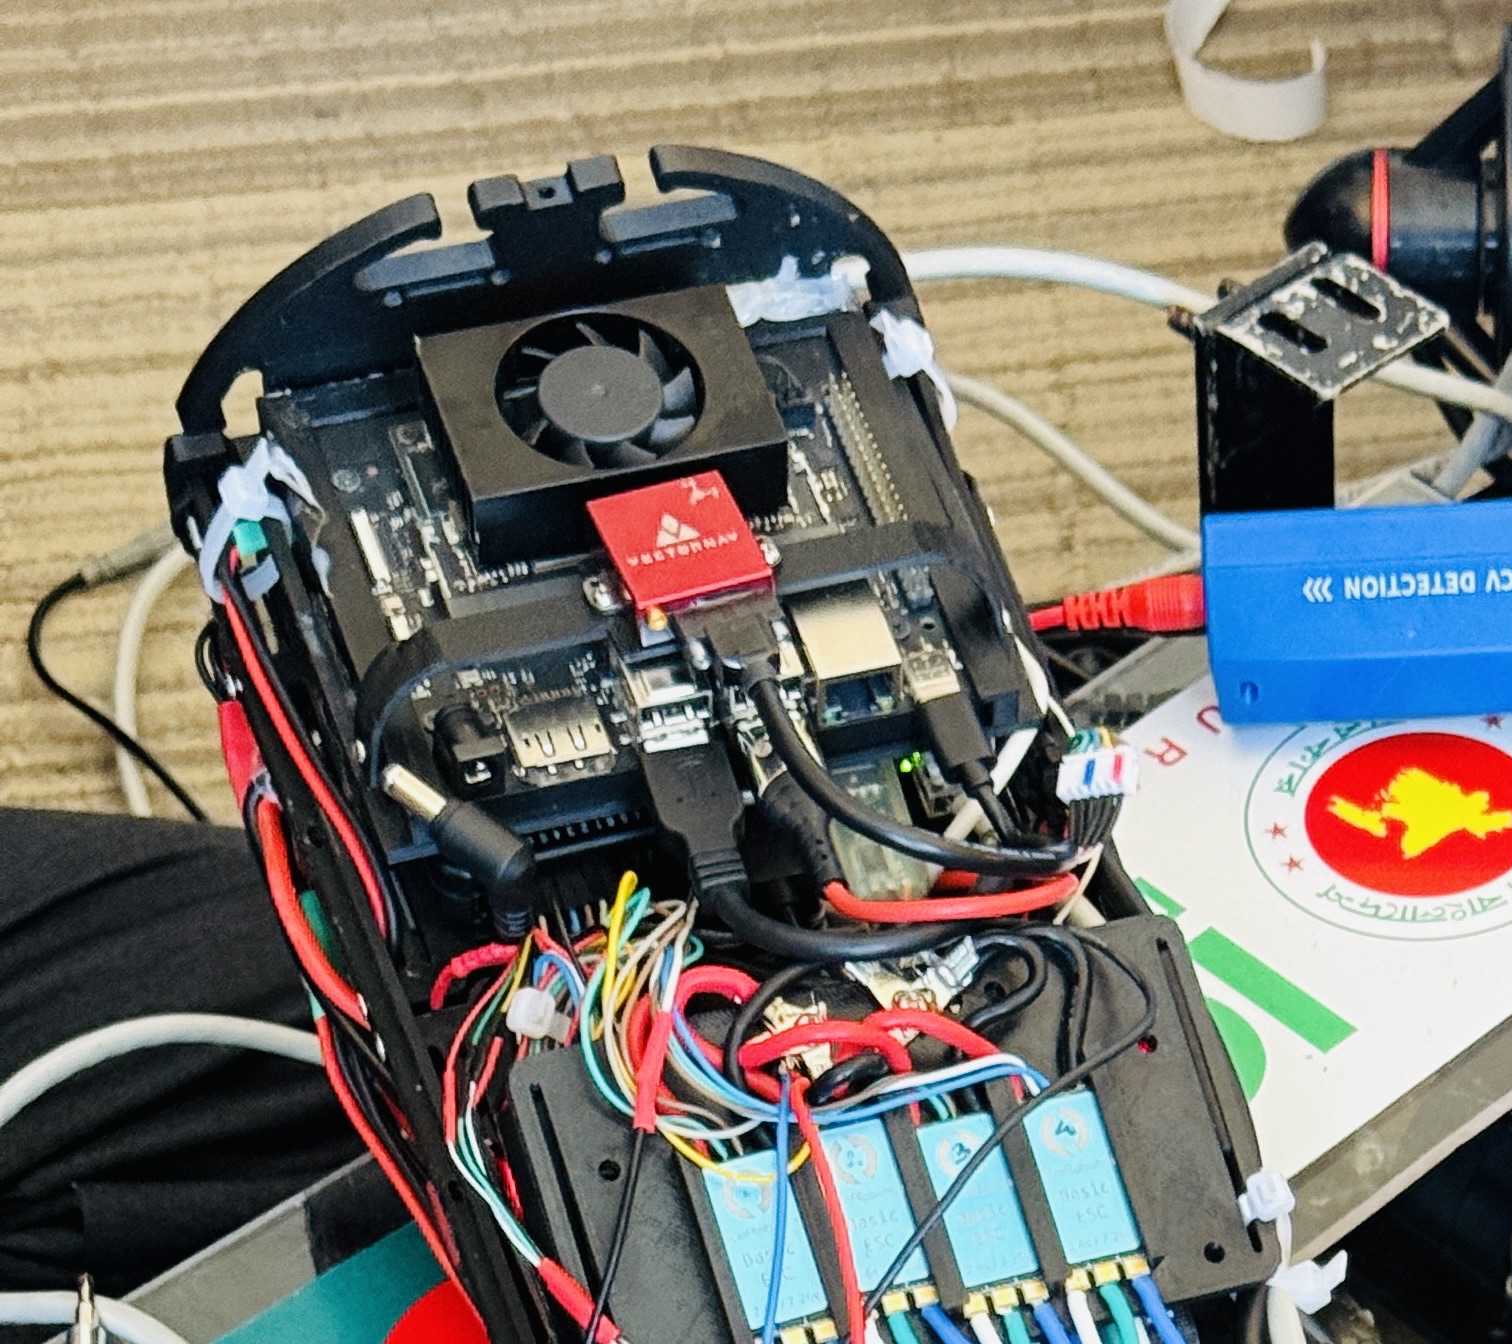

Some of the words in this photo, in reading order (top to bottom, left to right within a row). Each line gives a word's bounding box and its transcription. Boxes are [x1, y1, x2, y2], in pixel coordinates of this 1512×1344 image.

[1343, 570, 1476, 600] DETECTION
[1315, 884, 1508, 923] বাংলাদেশ
[951, 1142, 972, 1166] 3
[760, 1266, 798, 1288] EC
